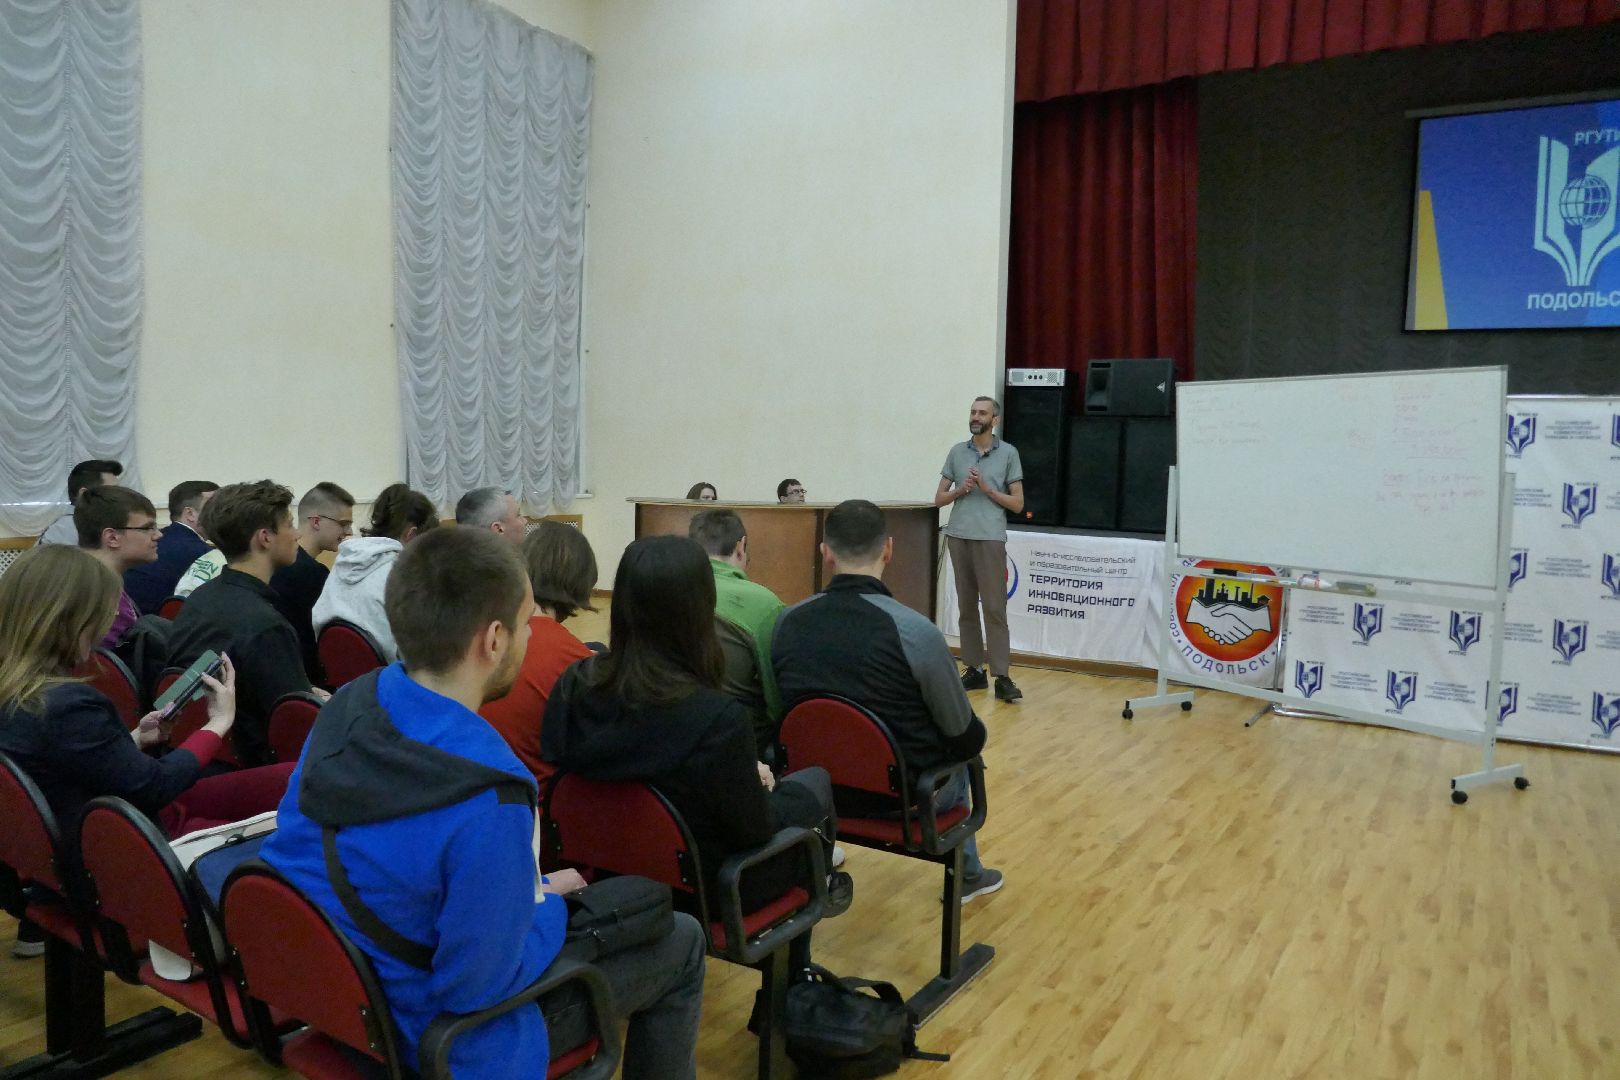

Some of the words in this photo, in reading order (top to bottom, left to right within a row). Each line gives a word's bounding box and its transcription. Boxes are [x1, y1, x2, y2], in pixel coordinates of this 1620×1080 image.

[1029, 574, 1103, 590] ТЕРРИТОРИЯ
[1028, 588, 1136, 607] ИННОВАЦИОННОГО
[1027, 604, 1085, 619] РАЗВИТИЯ
[1181, 644, 1270, 675] ПОДОЛЬСК
